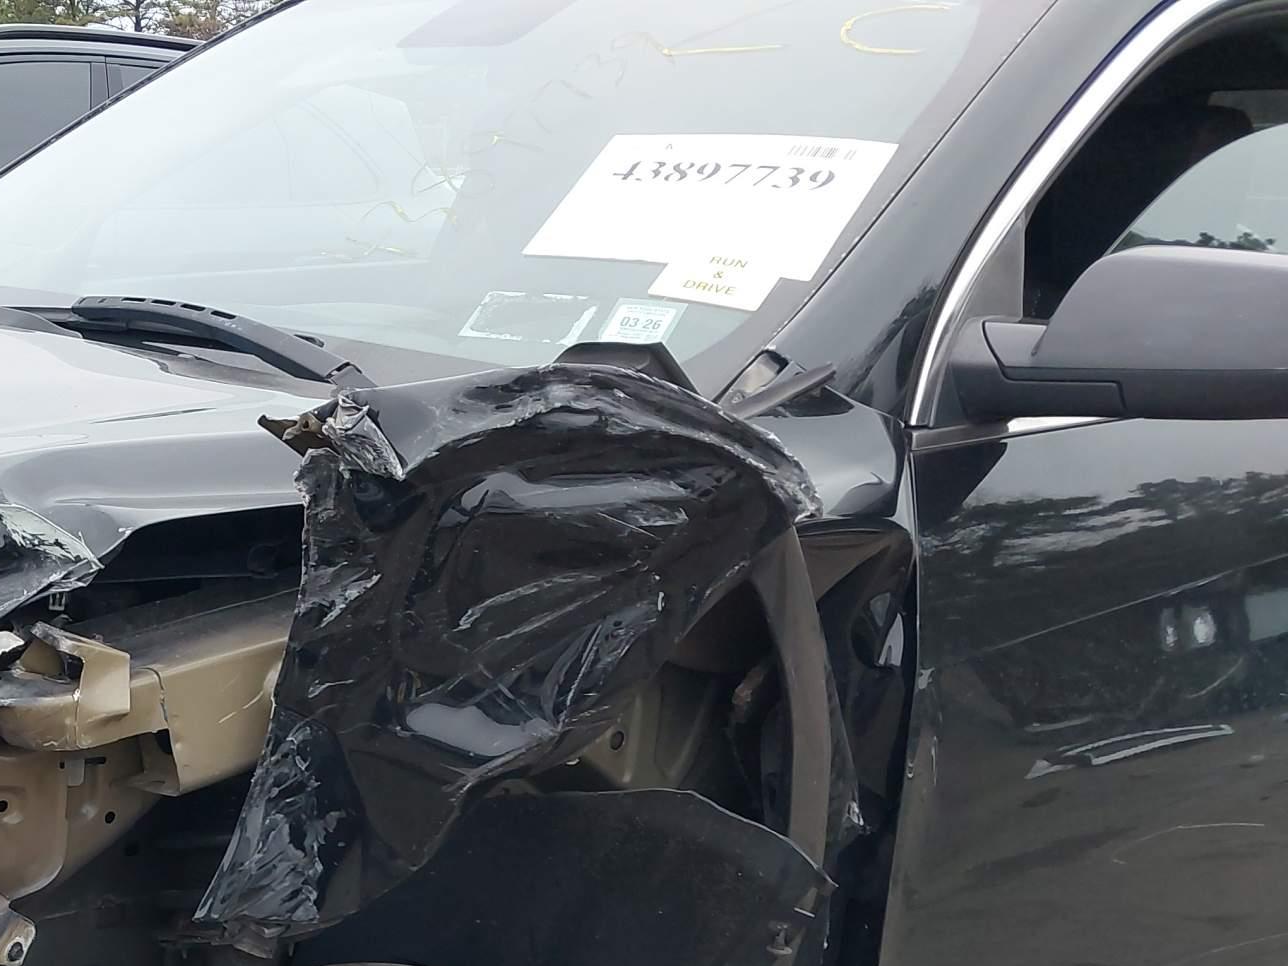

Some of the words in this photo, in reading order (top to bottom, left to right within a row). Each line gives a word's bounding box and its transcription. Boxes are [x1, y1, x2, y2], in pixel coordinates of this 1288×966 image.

[613, 160, 836, 190] 43897739
[710, 256, 748, 269] RUN
[712, 270, 724, 279] &
[682, 280, 737, 295] DRIVE
[619, 316, 641, 328] 03
[642, 318, 664, 330] 26
